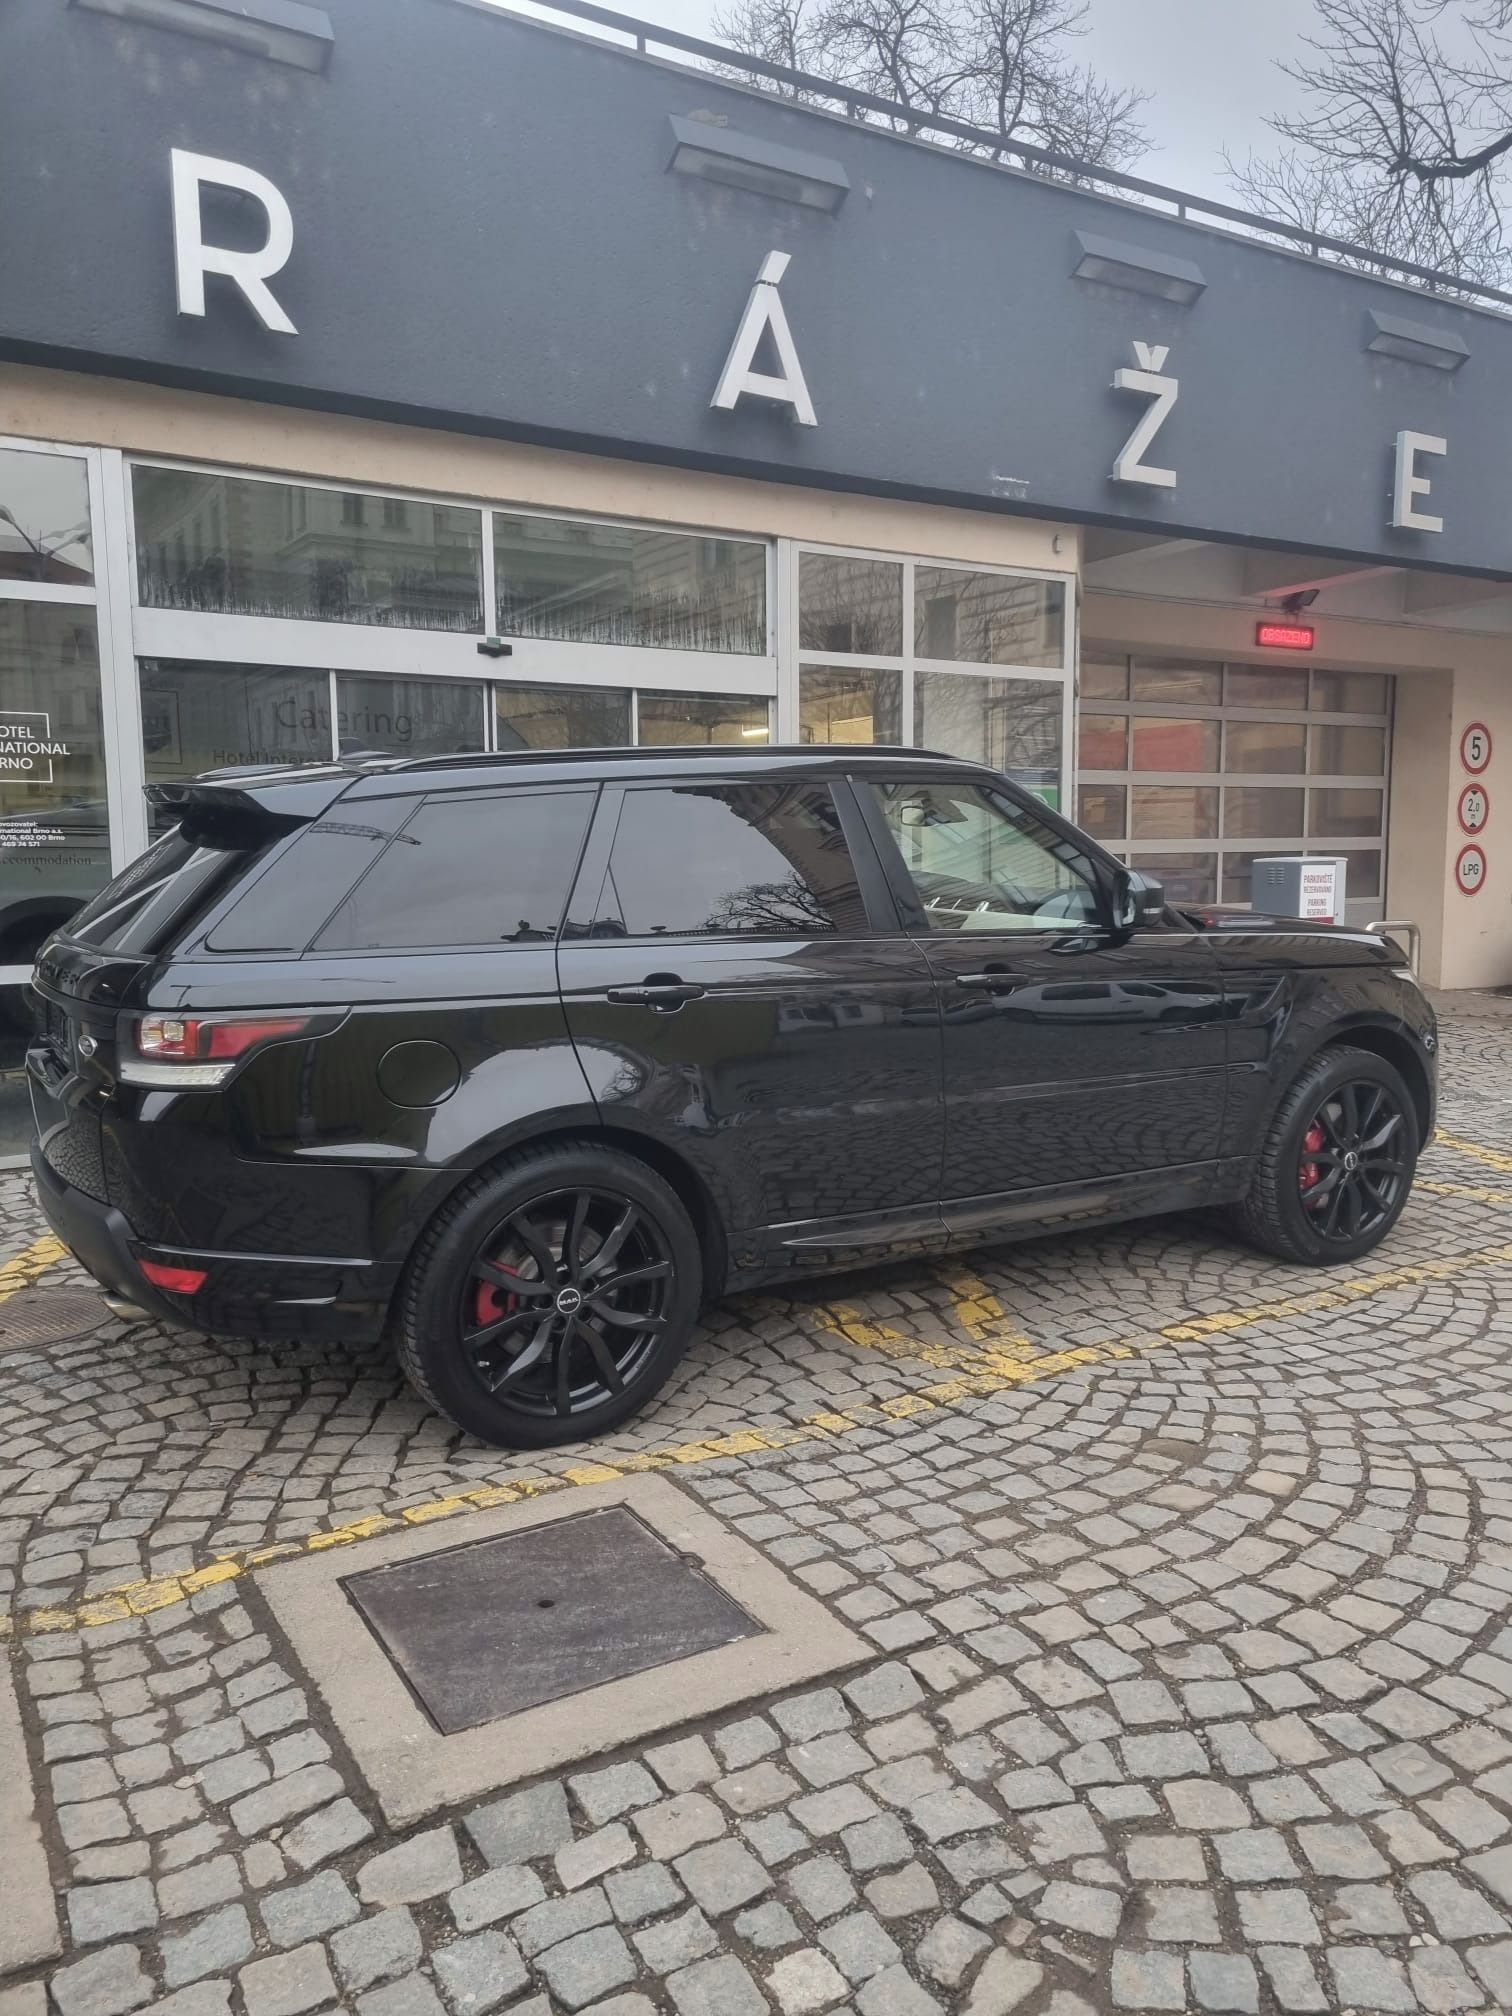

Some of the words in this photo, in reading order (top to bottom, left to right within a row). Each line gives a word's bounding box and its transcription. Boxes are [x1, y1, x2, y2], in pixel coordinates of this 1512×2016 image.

[276, 699, 414, 742] Catering
[1471, 736, 1482, 761] 5
[1463, 863, 1479, 876] LPG
